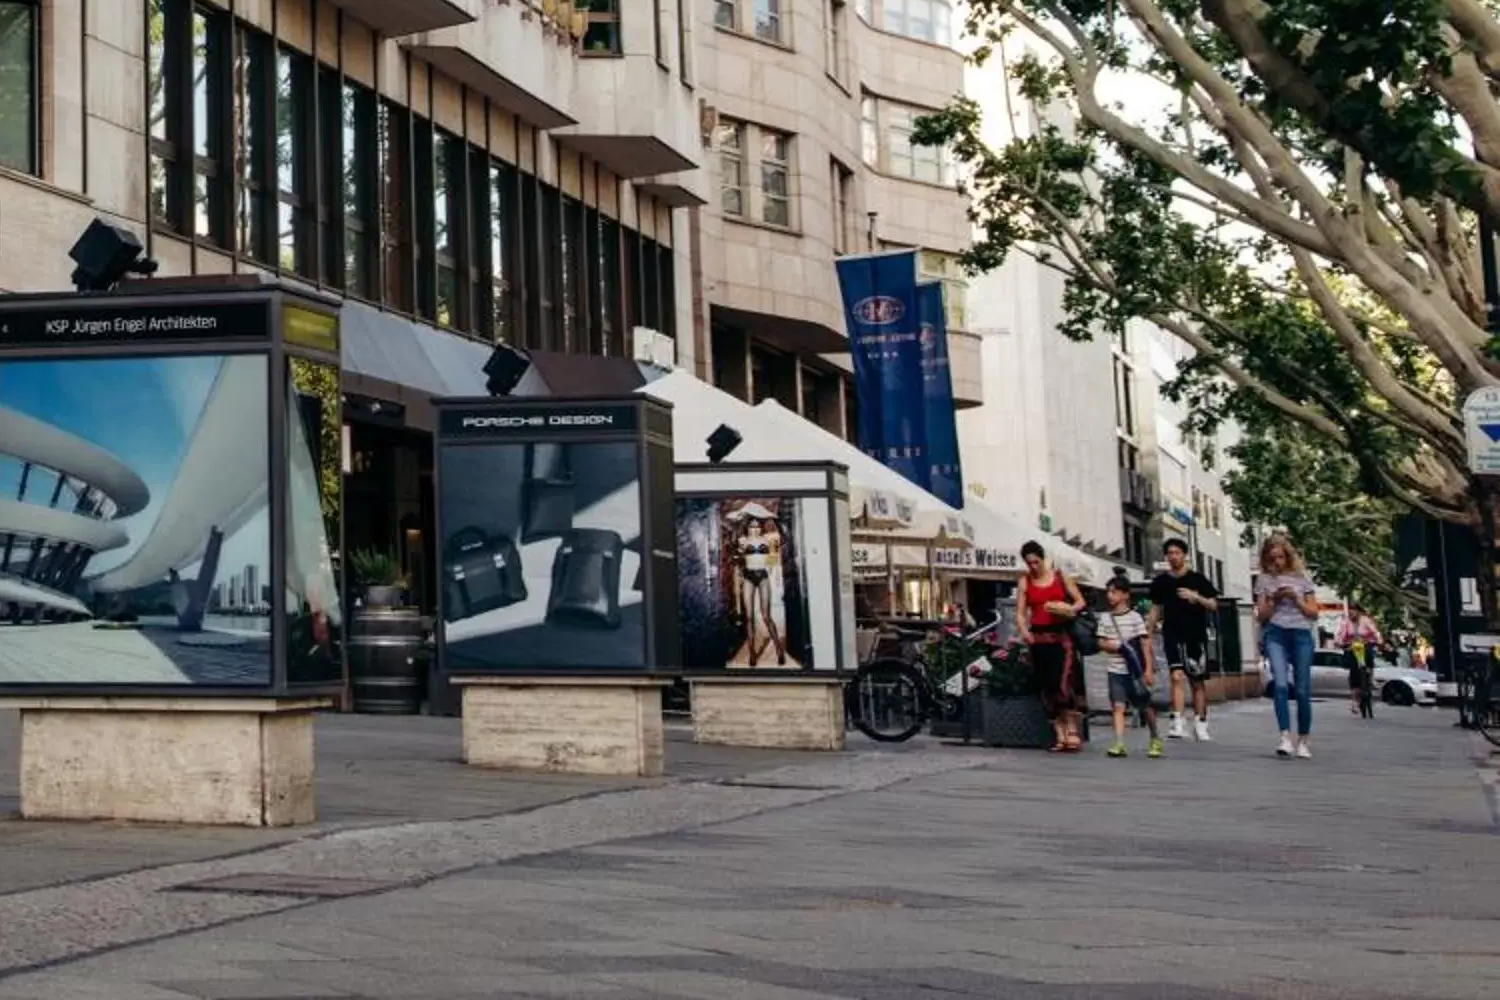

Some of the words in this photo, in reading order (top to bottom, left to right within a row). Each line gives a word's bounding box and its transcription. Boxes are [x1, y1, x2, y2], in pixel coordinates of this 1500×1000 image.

[47, 319, 68, 333] KSP
[114, 317, 145, 333] Engel
[148, 315, 216, 331] Architekten
[463, 417, 544, 427] PORSCHE
[549, 415, 613, 425] DESIGN
[937, 551, 972, 565] aisel's
[975, 549, 1017, 566] Weisse
